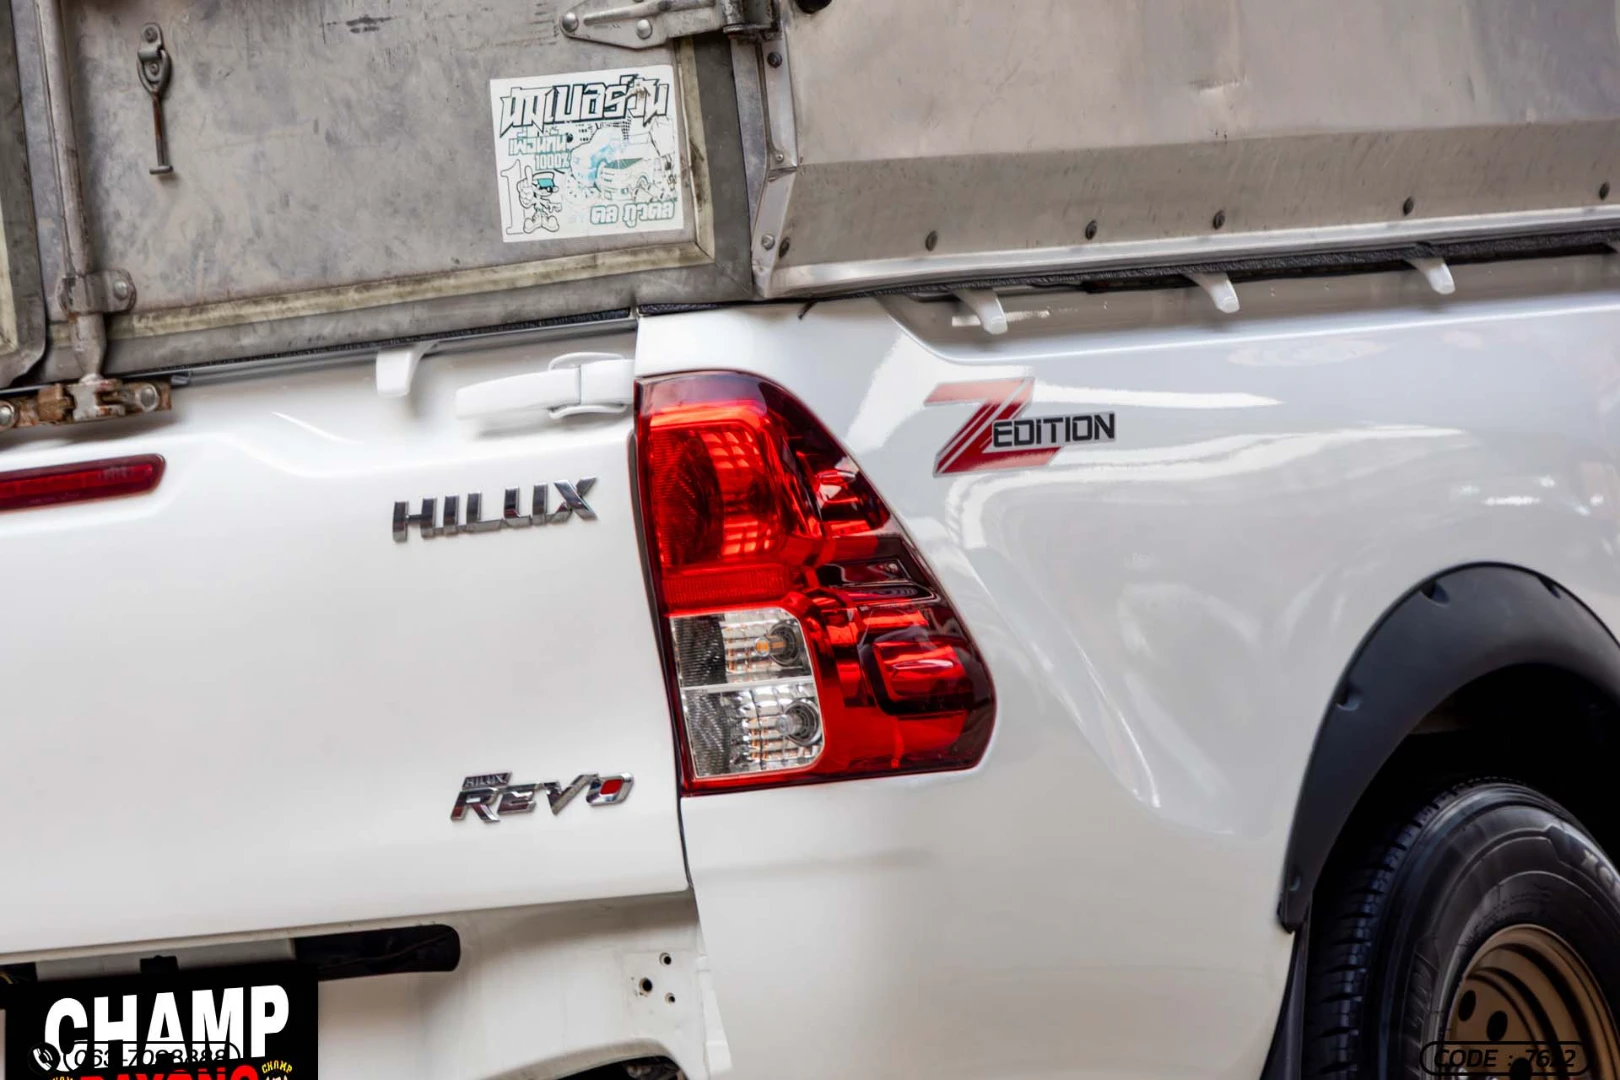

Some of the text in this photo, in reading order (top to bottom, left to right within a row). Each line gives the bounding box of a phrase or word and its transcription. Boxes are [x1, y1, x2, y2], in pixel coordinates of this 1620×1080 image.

[924, 376, 1116, 477] Z EDITION
[392, 476, 598, 542] HILUX
[450, 772, 634, 824] REVO
[463, 772, 512, 789] HILUX
